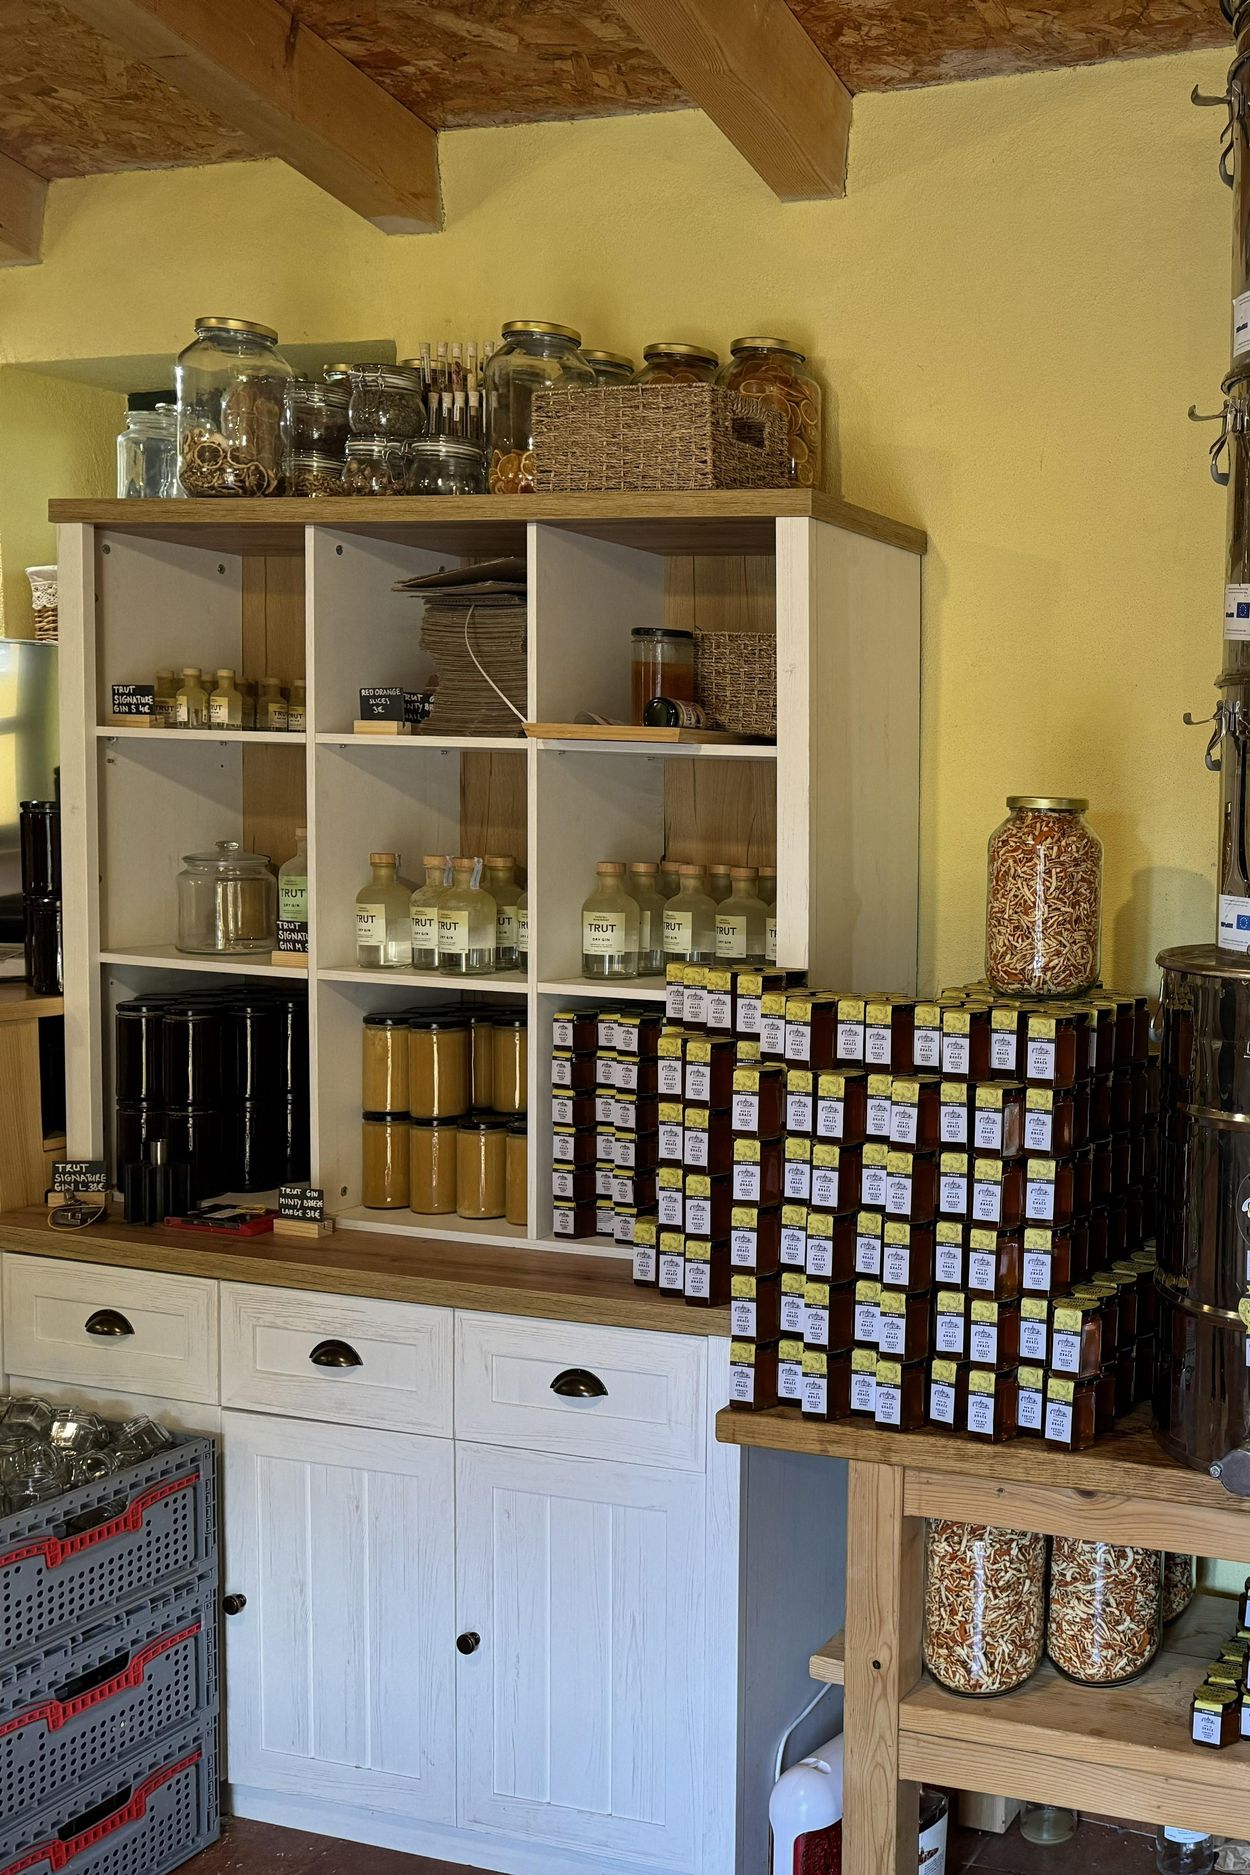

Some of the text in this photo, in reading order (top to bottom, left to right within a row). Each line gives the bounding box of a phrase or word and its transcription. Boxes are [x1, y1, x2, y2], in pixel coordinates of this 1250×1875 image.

[374, 688, 401, 696] ORANGE
[113, 695, 154, 705] SIGNATURE
[114, 705, 128, 713] GIN
[280, 888, 306, 898] TRUT
[357, 914, 376, 924] TRUT
[412, 918, 434, 927] TRUT
[276, 921, 301, 930] TRUT
[438, 921, 459, 931] TRUT
[588, 923, 616, 933] TRUT
[664, 922, 682, 932] TRUT
[716, 926, 737, 936] TRUT
[280, 942, 294, 950] GIN
[295, 942, 303, 951] M
[55, 1164, 89, 1172] TRUT
[54, 1173, 107, 1182] SIGNATURE
[54, 1183, 74, 1191] GIN
[280, 1187, 319, 1197] TRUT GIN
[279, 1197, 301, 1209] MINTY
[281, 1208, 303, 1217] LARGE
